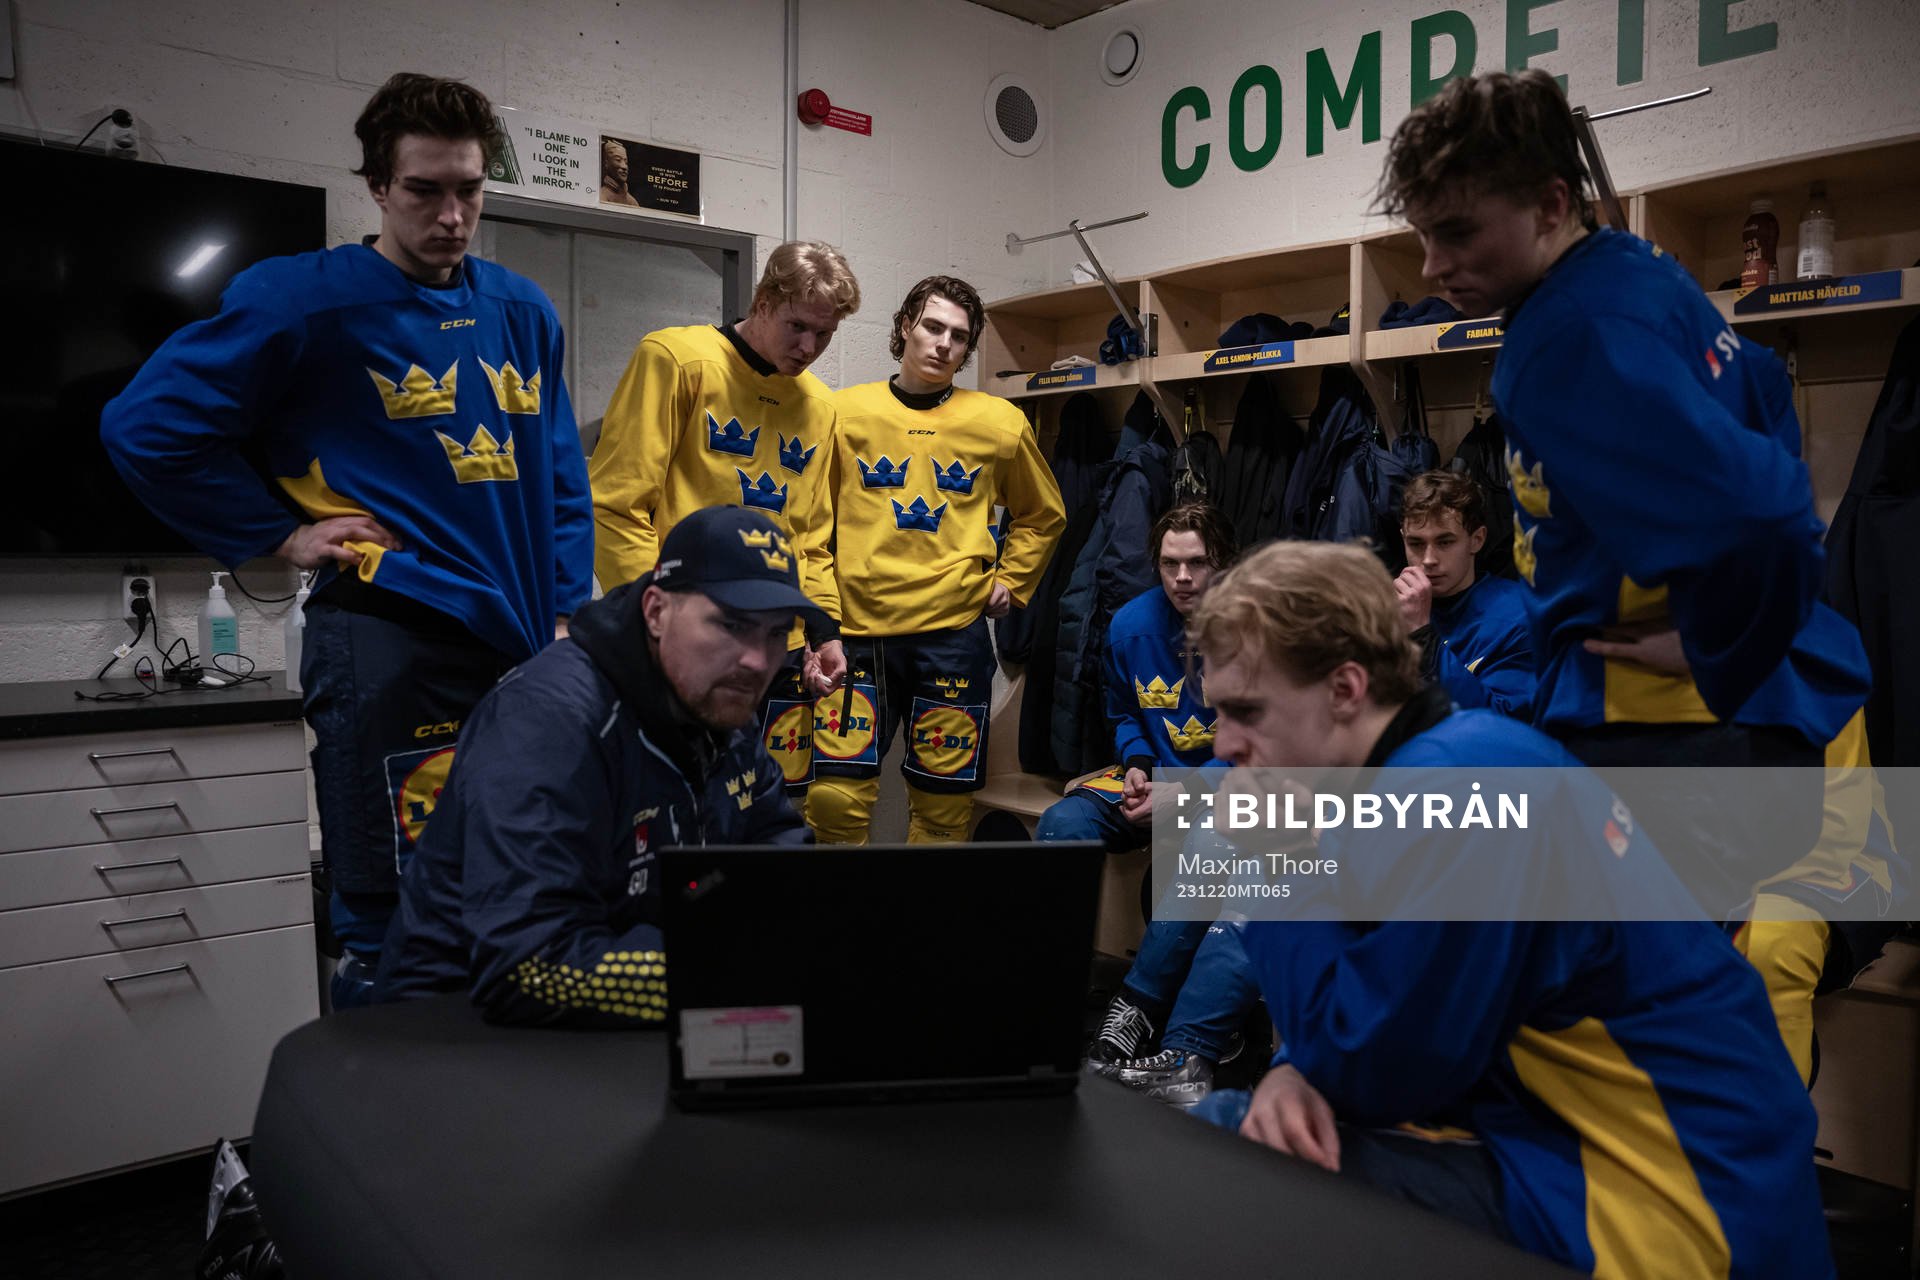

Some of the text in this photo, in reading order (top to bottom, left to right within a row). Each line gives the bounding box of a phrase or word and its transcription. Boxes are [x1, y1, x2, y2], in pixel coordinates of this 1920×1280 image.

[536, 129, 570, 144] BLAME
[573, 136, 588, 147] NO
[544, 142, 568, 154] ONE.
[539, 153, 567, 166] LOOK
[570, 160, 579, 168] IN
[546, 166, 566, 177] THE
[532, 175, 580, 190] MIRROR."
[647, 174, 688, 188] BEFORE
[1769, 284, 1861, 305] MATTIAS HÄVELID
[440, 318, 476, 330] CCM
[1215, 356, 1229, 366] AXEL
